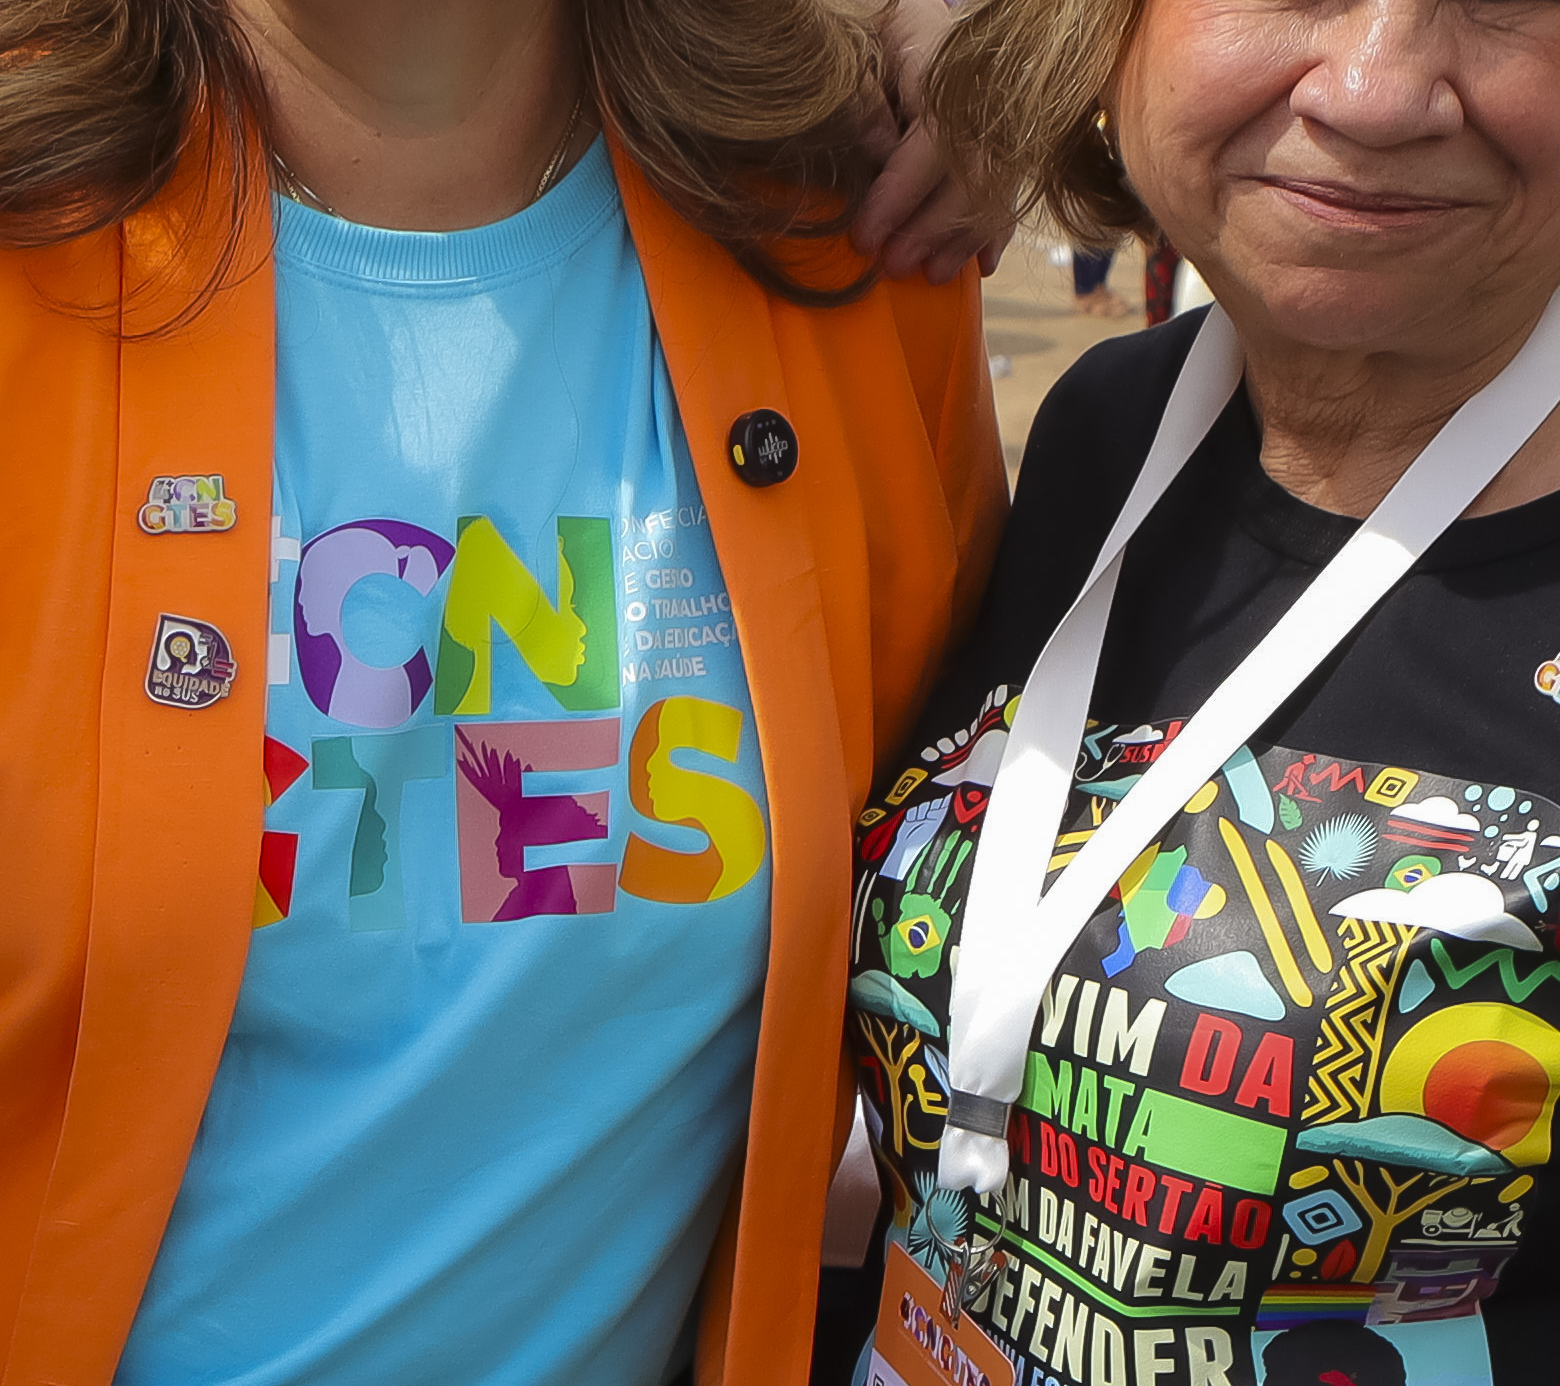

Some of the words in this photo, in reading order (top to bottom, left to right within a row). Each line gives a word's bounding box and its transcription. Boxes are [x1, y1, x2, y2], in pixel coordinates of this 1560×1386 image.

[1032, 1050, 1157, 1161] MATA
[1040, 973, 1168, 1077] VIM
[1179, 1012, 1294, 1118] DA
[1038, 1186, 1075, 1259] DA
[1079, 1211, 1248, 1302] FAVELA
[1040, 1120, 1079, 1188] DO
[1087, 1146, 1273, 1250] SERTÃO
